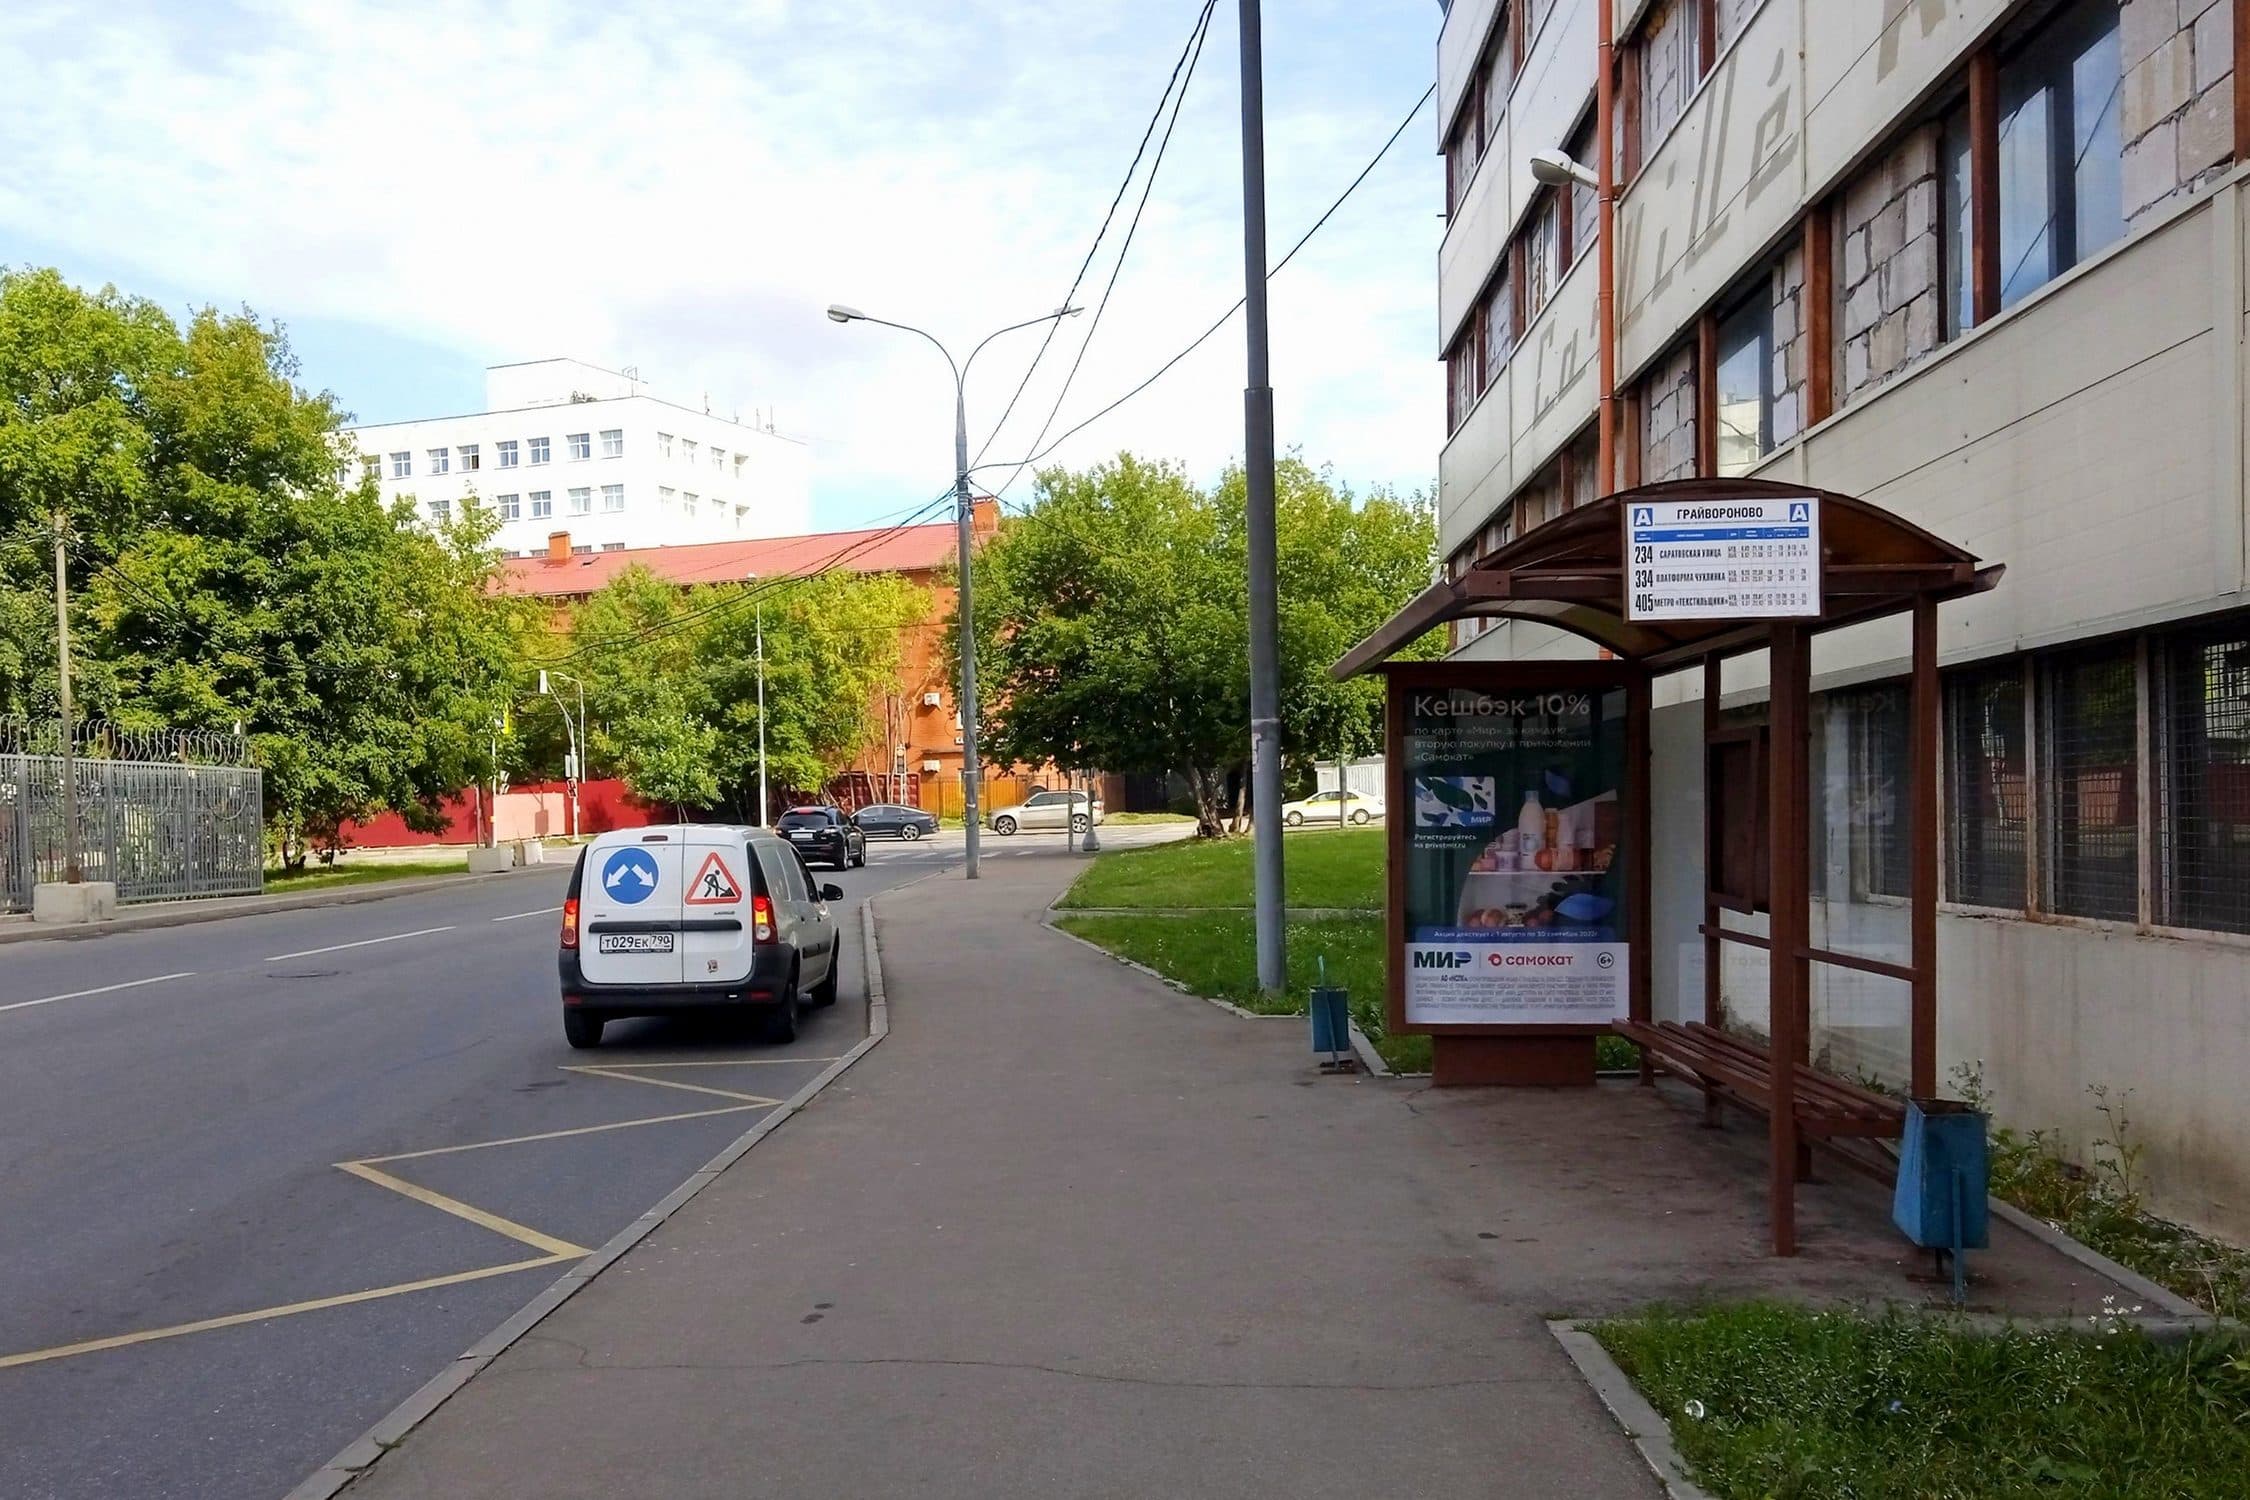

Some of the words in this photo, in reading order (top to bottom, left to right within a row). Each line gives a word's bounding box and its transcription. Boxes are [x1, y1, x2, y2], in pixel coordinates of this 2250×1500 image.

[1677, 507, 1763, 520] ГРАЙВОРОНОВО
[1635, 545, 1653, 564] 234
[1659, 549, 1701, 559] САРАТОВСКАЯ
[1701, 548, 1722, 558] УЛИЦА
[1635, 569, 1653, 588] 334
[1656, 573, 1693, 583] ПЛАТФОРМА
[1635, 593, 1654, 612] 405
[1654, 598, 1674, 607] МЕТРО
[1414, 695, 1526, 717] Кешбэк
[1536, 694, 1591, 715] 10%
[1414, 727, 1429, 736] по
[1431, 727, 1463, 738] карте
[1414, 741, 1456, 751] вторую
[1459, 740, 1507, 751] покупку
[1414, 752, 1475, 762] «Самокат»
[651, 935, 670, 944] 790
[1413, 951, 1472, 968] МИР
[1505, 955, 1574, 966] самокат
